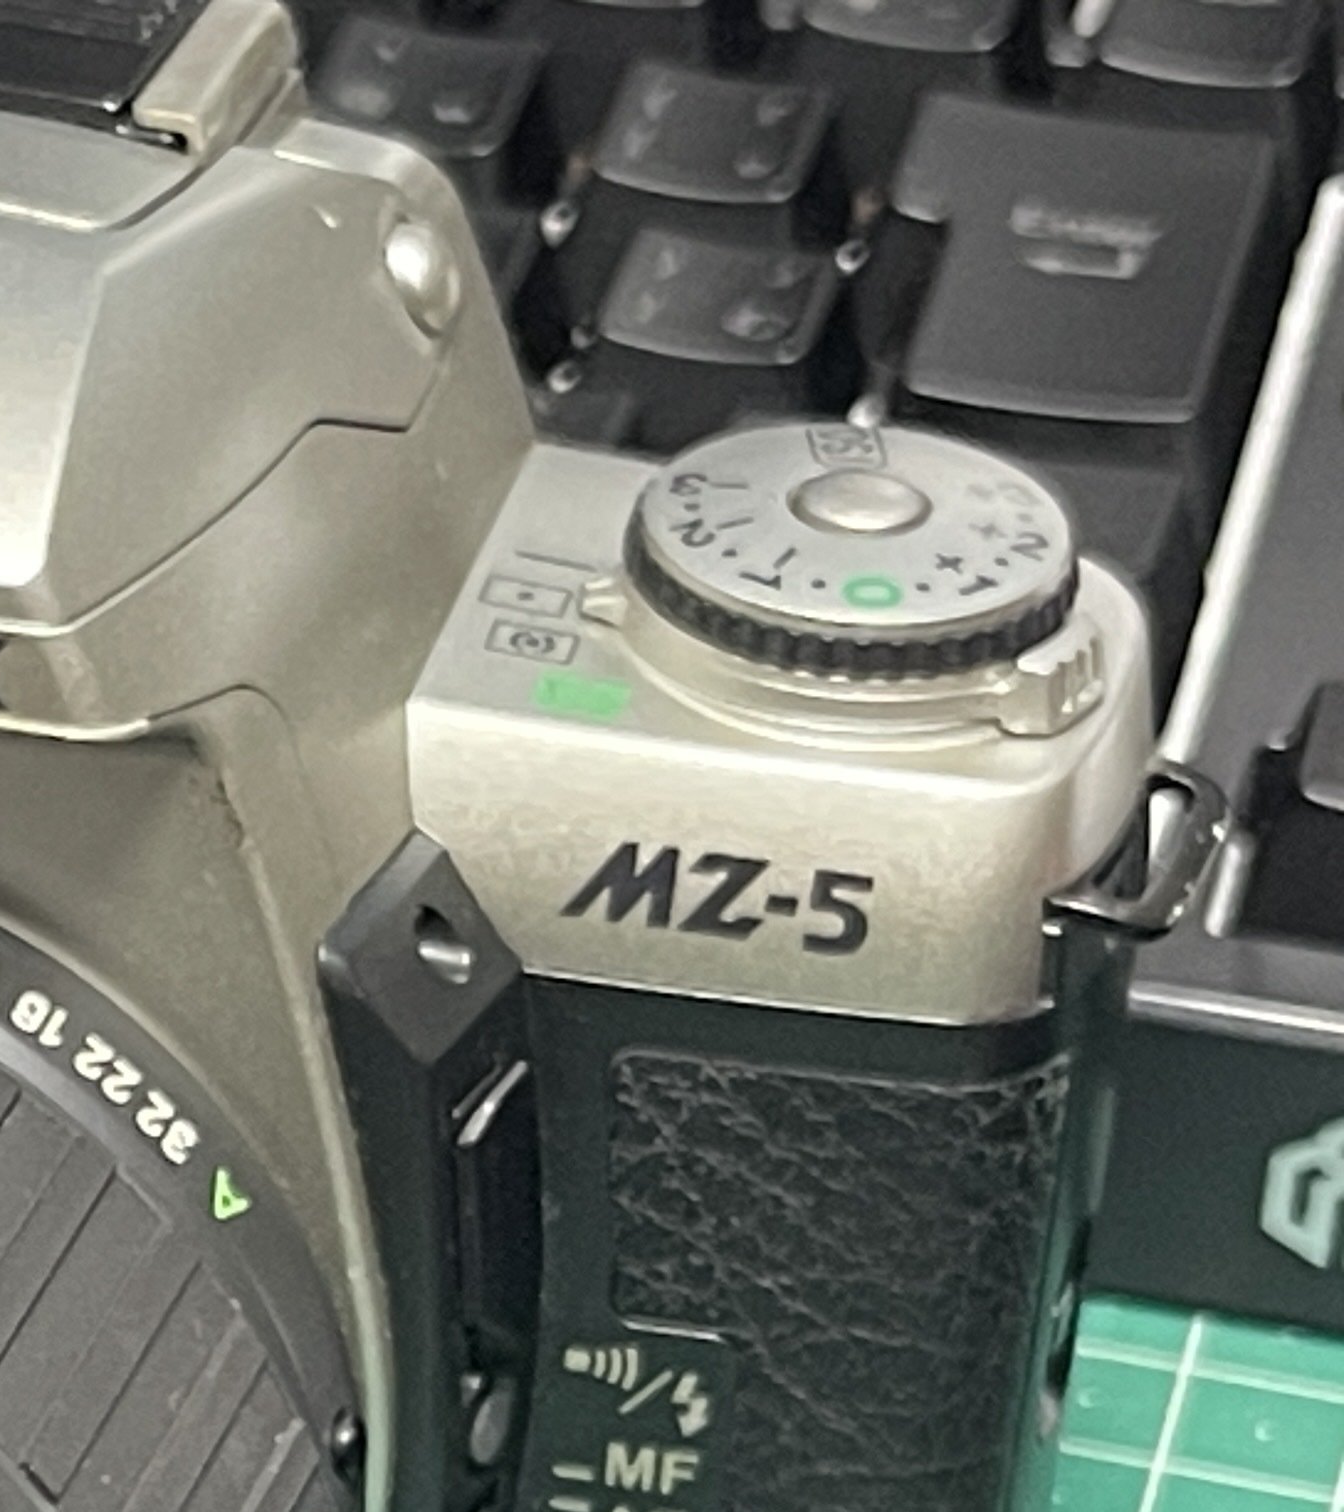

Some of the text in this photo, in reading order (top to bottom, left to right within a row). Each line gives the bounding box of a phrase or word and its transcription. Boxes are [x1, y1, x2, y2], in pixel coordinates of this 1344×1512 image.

[559, 841, 874, 956] MZ-5
[72, 1033, 144, 1105] 22
[134, 1088, 202, 1166] 32
[212, 1166, 252, 1221] A
[602, 1440, 700, 1495] MF
